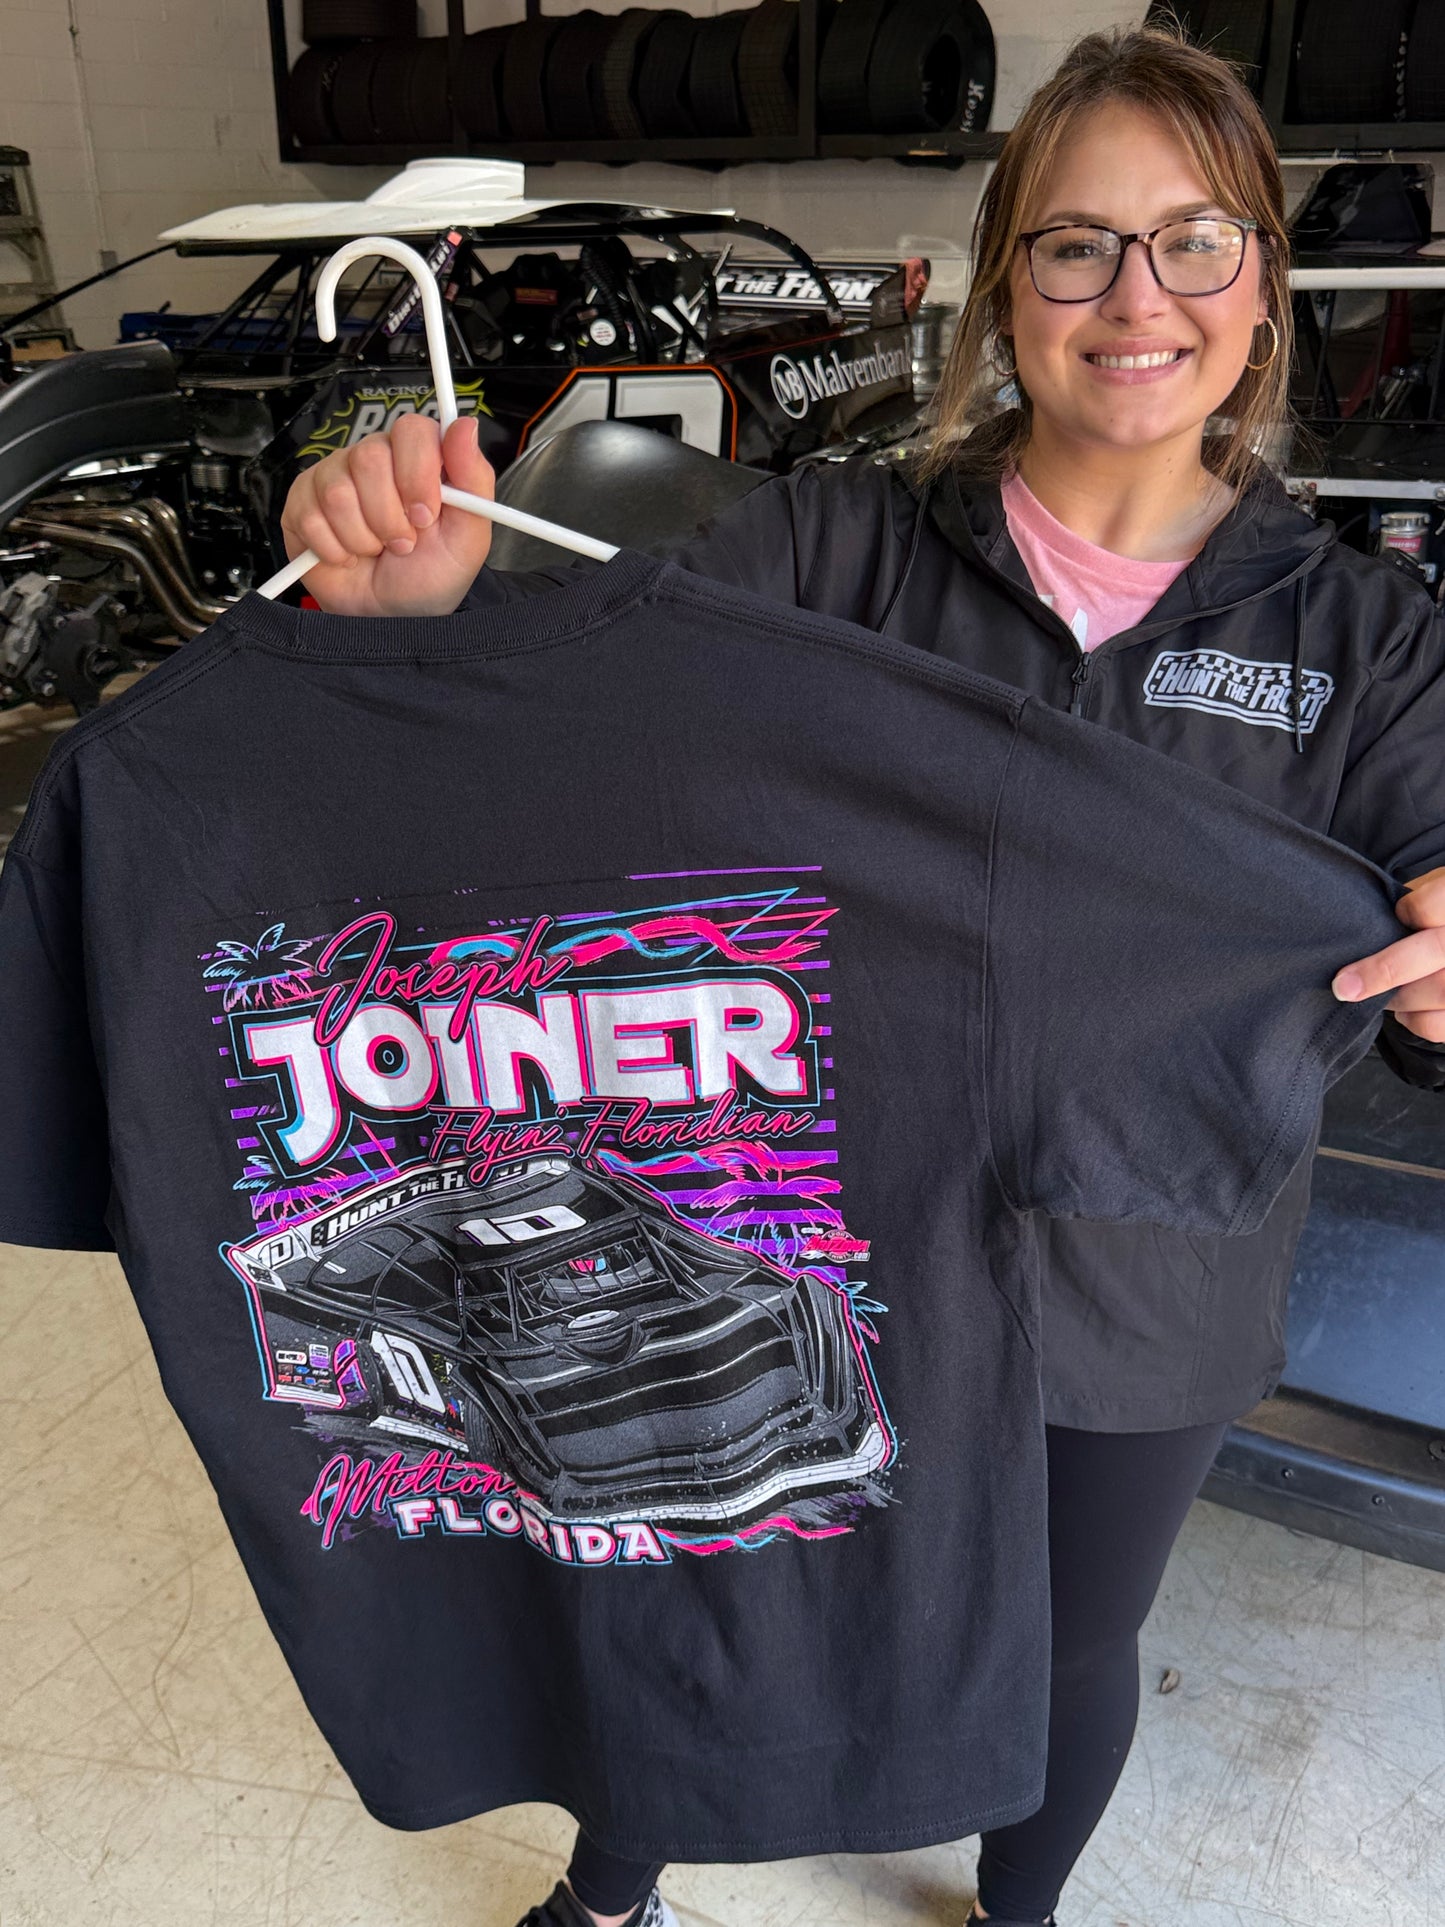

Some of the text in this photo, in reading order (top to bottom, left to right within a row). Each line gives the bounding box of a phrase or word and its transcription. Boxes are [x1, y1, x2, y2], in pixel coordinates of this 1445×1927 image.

[733, 280, 778, 294] THE
[361, 384, 431, 397] RACING
[797, 334, 913, 402] Malvernbank
[1157, 661, 1227, 698] HUNT
[1224, 680, 1251, 703] THE
[315, 911, 573, 1045] Joseph
[246, 980, 807, 1166] JOINER
[580, 1088, 815, 1158] Floridian
[326, 1180, 441, 1240] HUNT THE
[308, 1450, 517, 1548] Milton
[394, 1497, 673, 1563] FLORIDA
